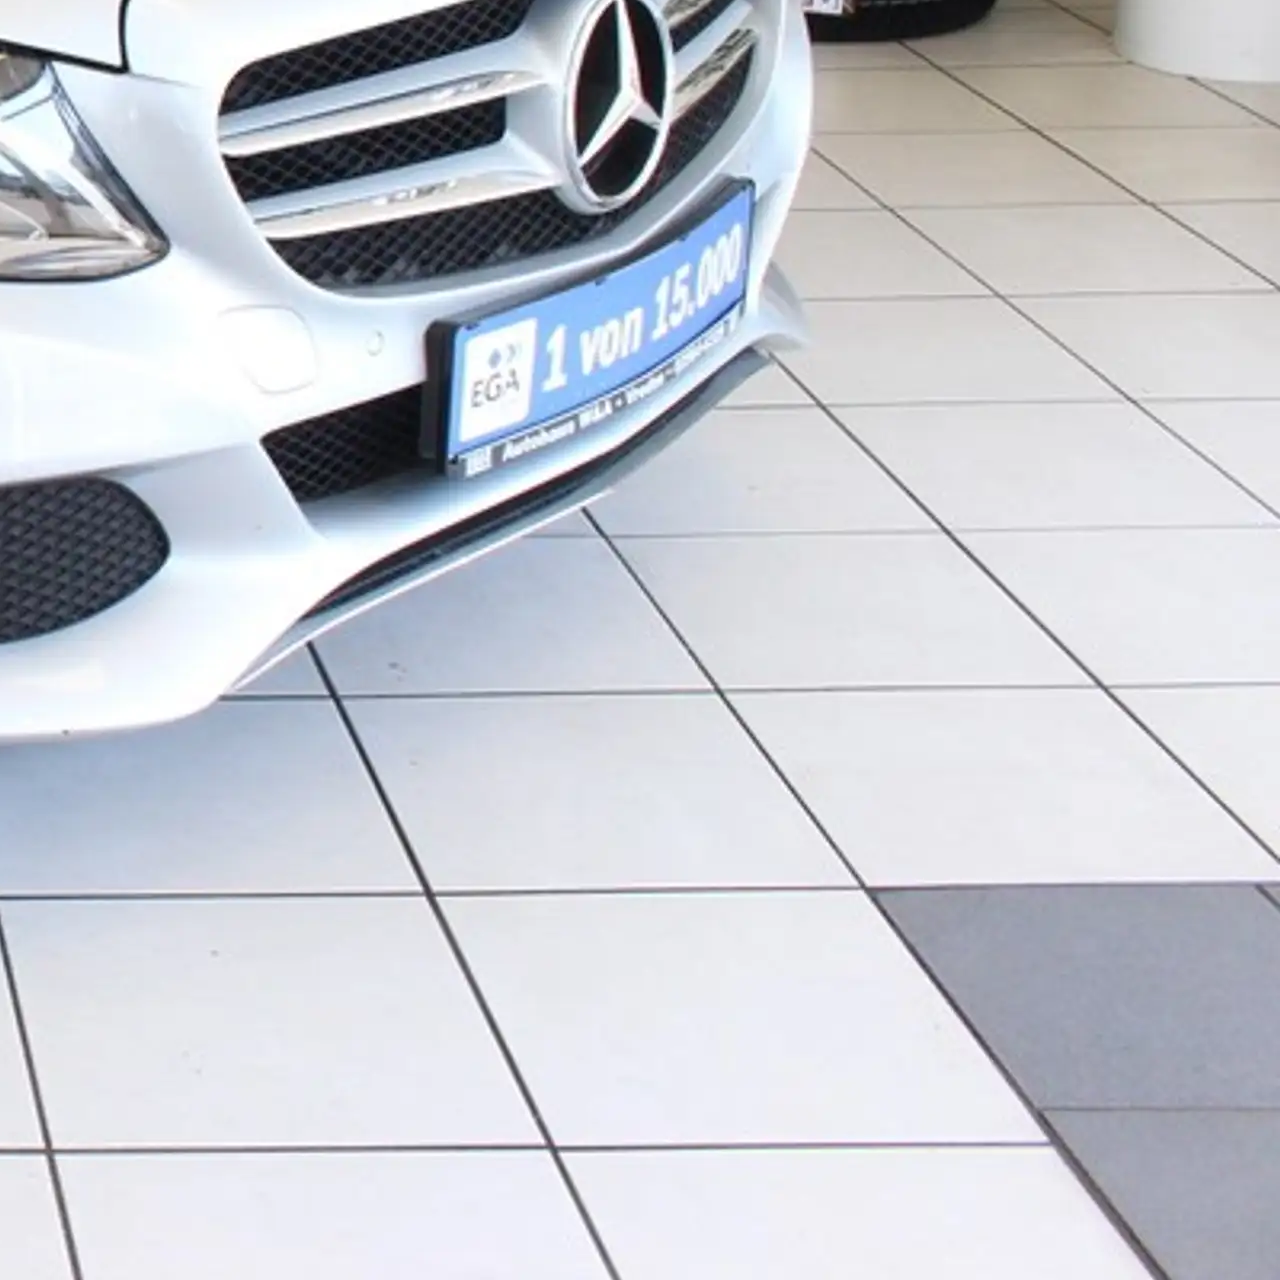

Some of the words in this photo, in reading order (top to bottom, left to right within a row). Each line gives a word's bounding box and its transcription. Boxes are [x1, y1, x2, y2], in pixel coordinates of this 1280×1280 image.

[542, 323, 569, 392] 1
[579, 306, 645, 377] von
[651, 222, 742, 341] 15.000
[470, 370, 521, 408] EGA
